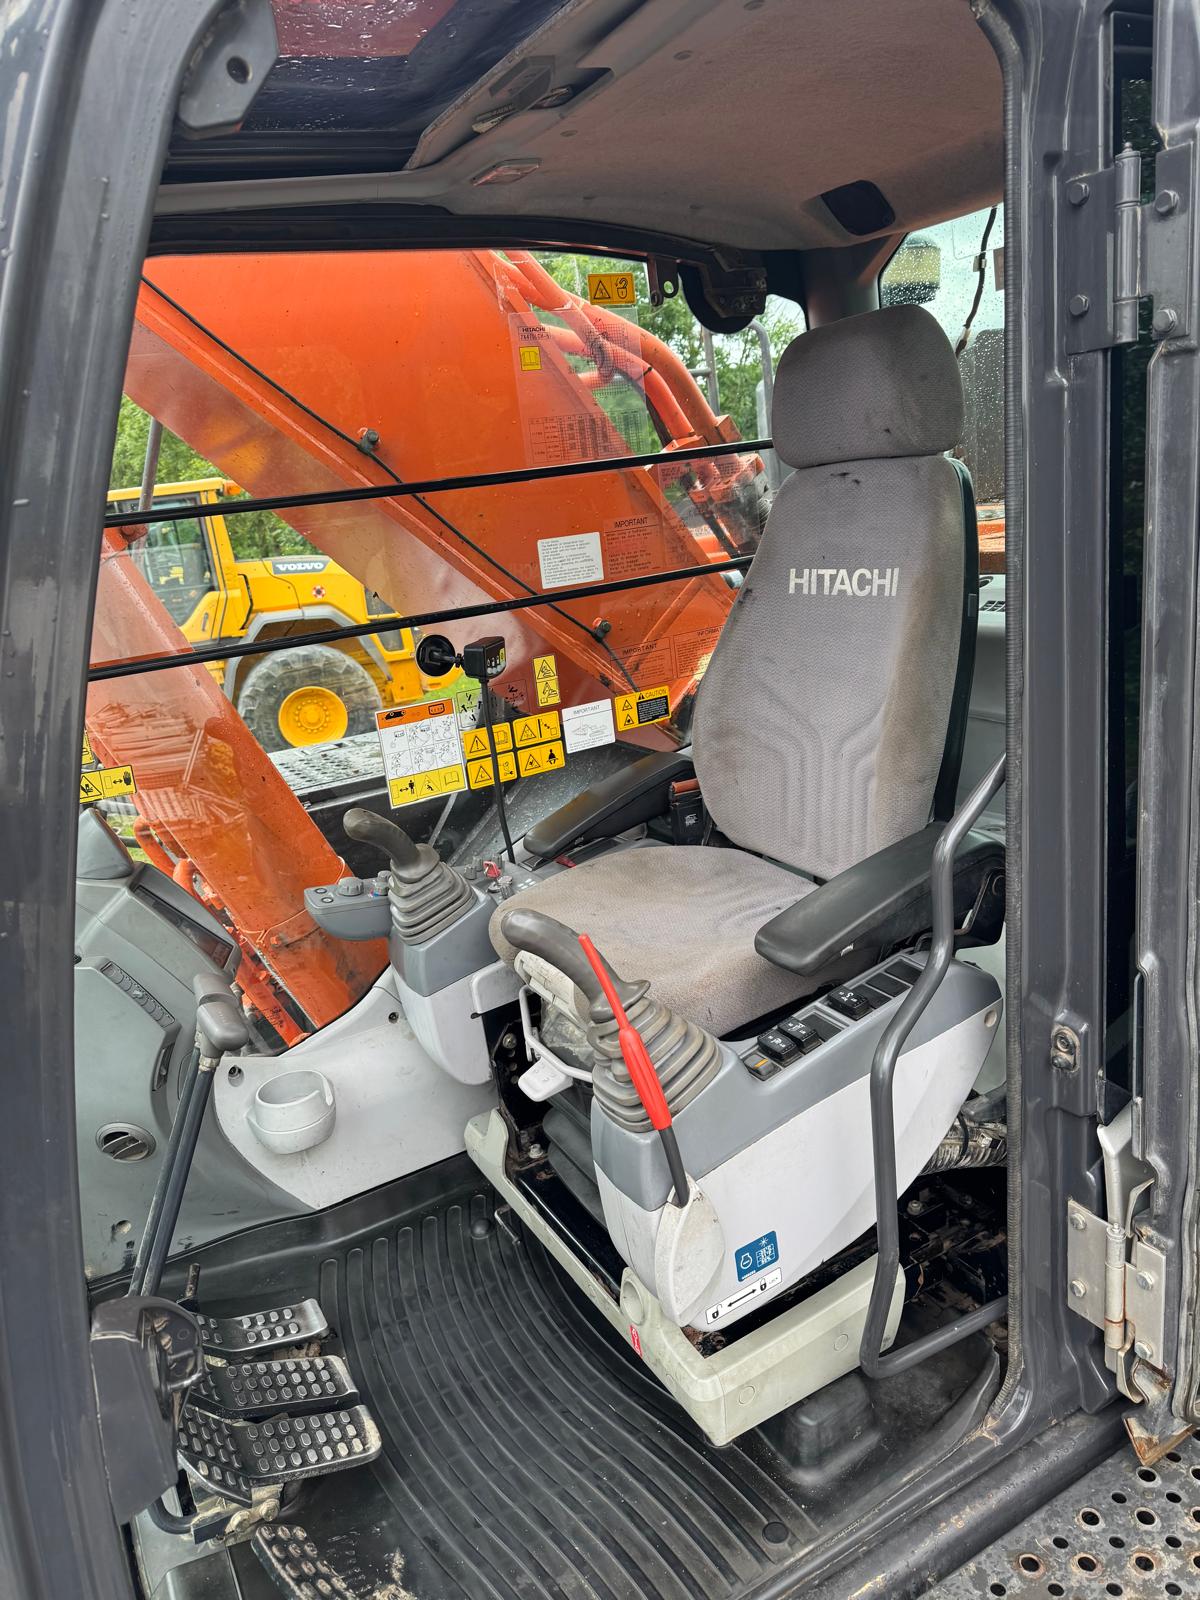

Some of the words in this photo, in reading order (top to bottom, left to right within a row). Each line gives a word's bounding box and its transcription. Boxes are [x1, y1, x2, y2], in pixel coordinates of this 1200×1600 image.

[613, 517, 648, 529] IMPORTANT
[275, 562, 324, 571] VOLVO
[788, 567, 900, 597] HITACHI
[622, 643, 657, 655] IMPORTANT
[645, 687, 667, 698] CAUTION
[573, 704, 600, 714] IMPORTANT
